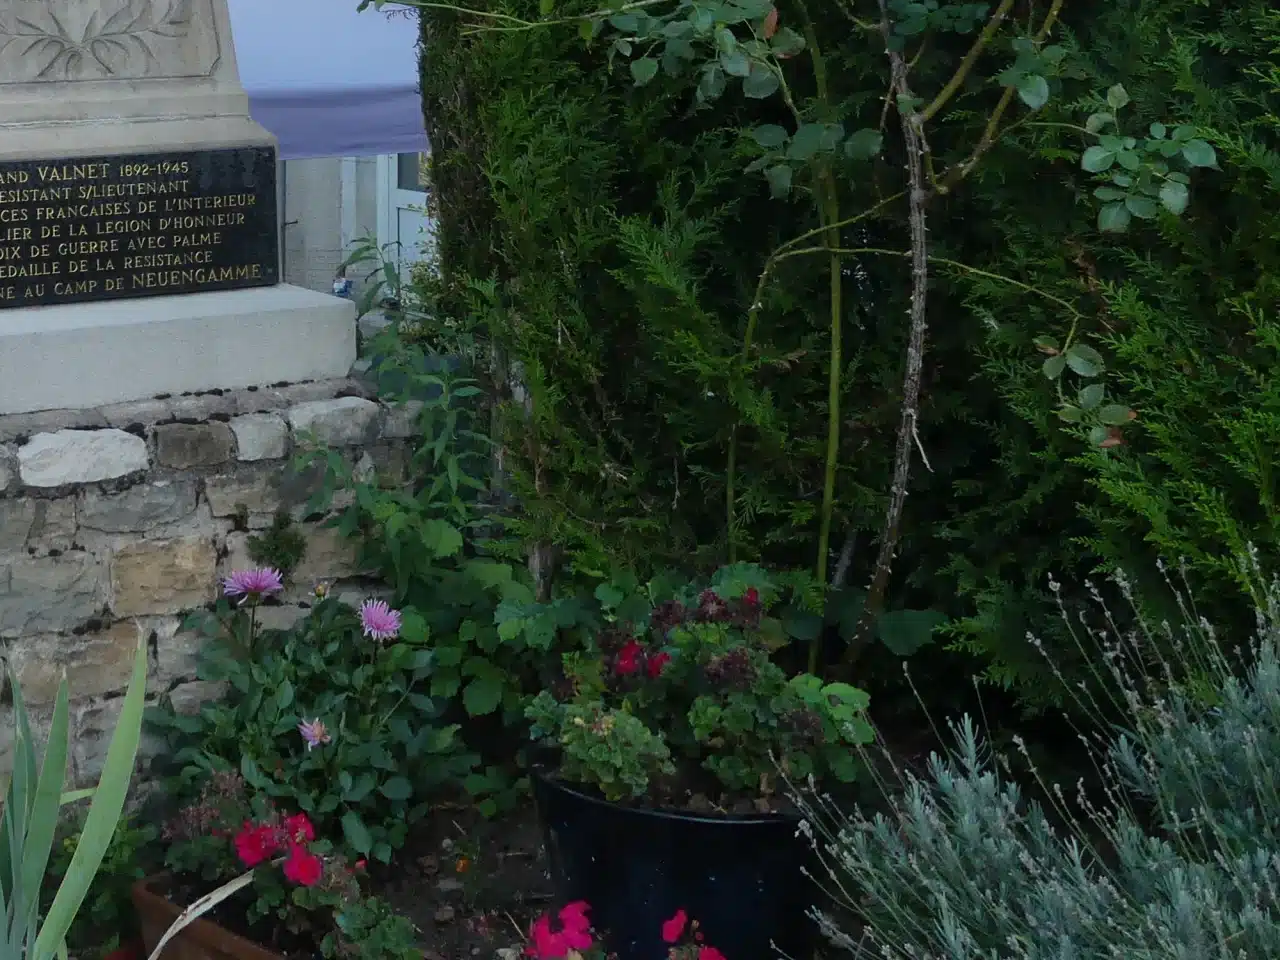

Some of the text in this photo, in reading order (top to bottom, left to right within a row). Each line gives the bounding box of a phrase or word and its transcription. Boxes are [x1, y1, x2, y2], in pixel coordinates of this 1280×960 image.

[38, 163, 110, 182] VALNET
[120, 161, 189, 178] 1892-1945
[79, 180, 189, 201] S/LIEUTENANT
[37, 202, 131, 221] FRANCAISES
[138, 200, 157, 214] DE
[166, 193, 256, 212] L'INTERIEUR
[41, 224, 61, 238] DE
[70, 223, 88, 237] LA
[97, 219, 152, 235] LEGION
[160, 213, 245, 231] D'HONNEUR
[31, 244, 51, 257] DE
[59, 239, 119, 256] GUERRE
[128, 235, 166, 251] AVEC
[173, 232, 222, 248] PALME
[69, 259, 88, 274] DE
[97, 256, 115, 272] LA
[124, 250, 213, 270] RESISTANCE
[24, 284, 45, 298] AU
[54, 280, 97, 296] CAMP
[105, 276, 125, 291] DE
[132, 263, 262, 289] NEUENGAMME
